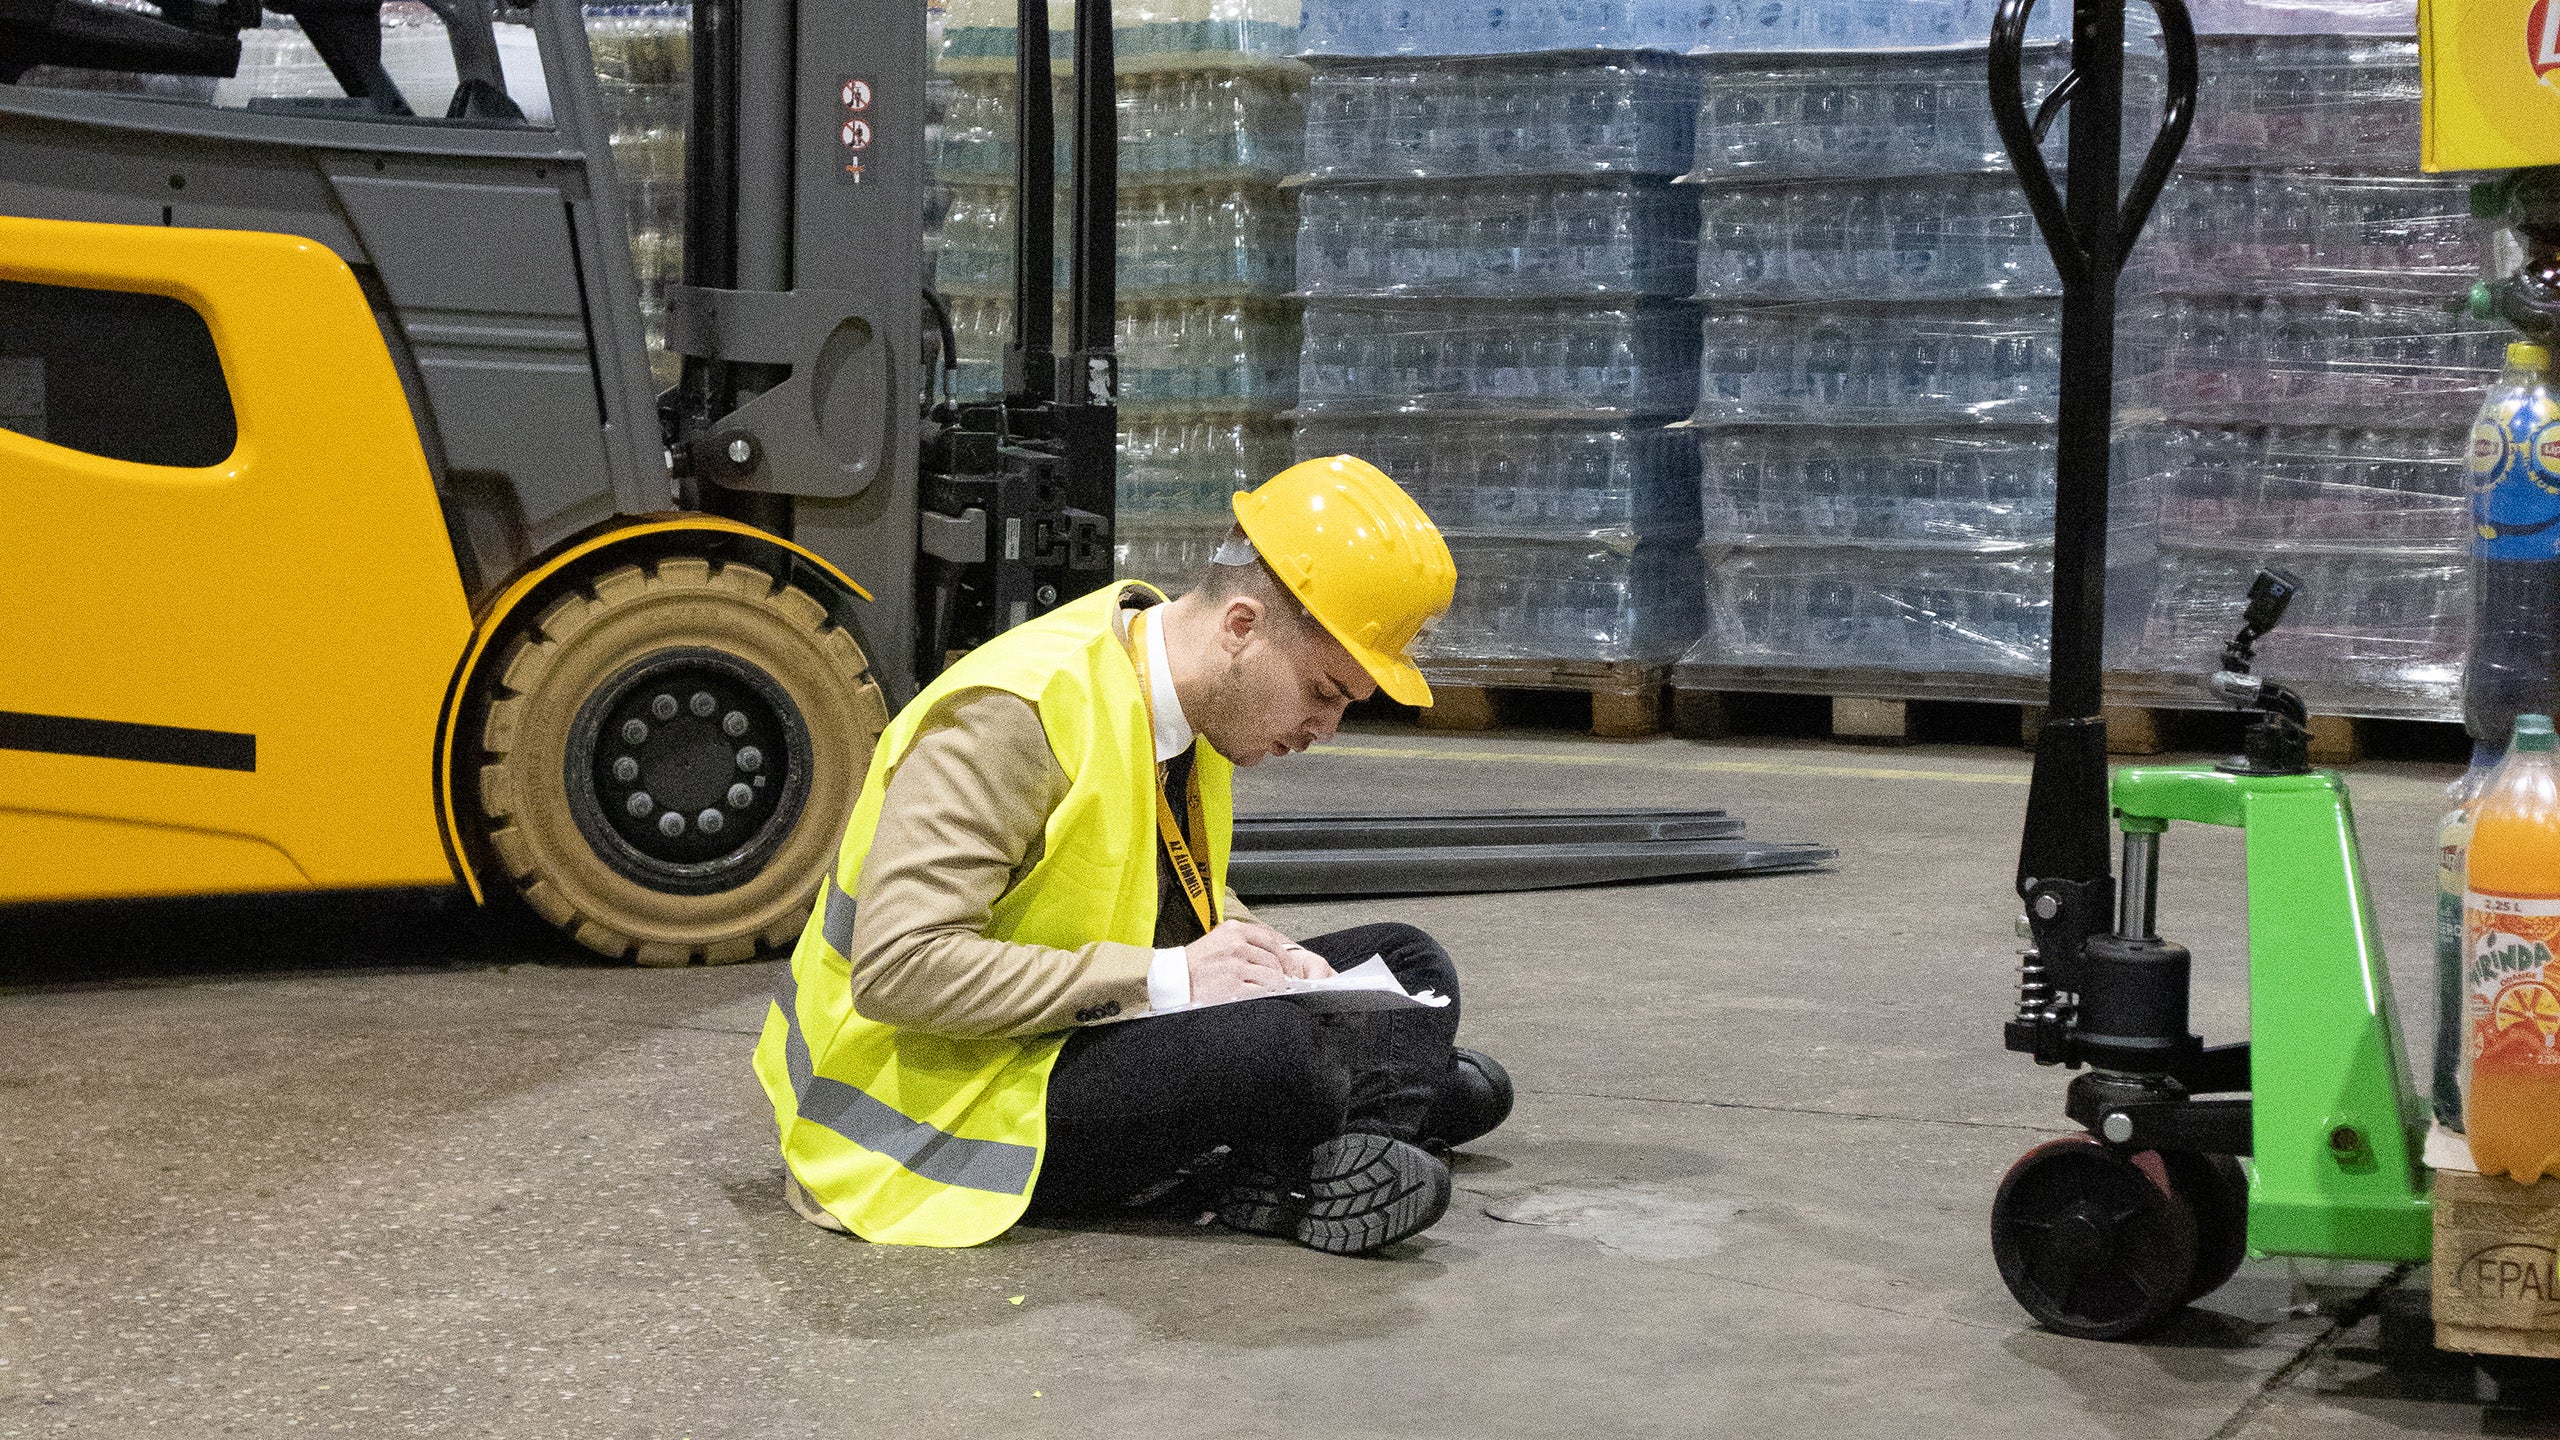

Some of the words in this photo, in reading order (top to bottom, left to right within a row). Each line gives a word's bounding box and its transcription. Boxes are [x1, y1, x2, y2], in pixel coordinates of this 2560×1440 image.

[1169, 840, 1183, 852] AZ
[2514, 902, 2522, 912] L
[2500, 971, 2538, 987] ORANGE
[2478, 1260, 2560, 1302] EPAL
